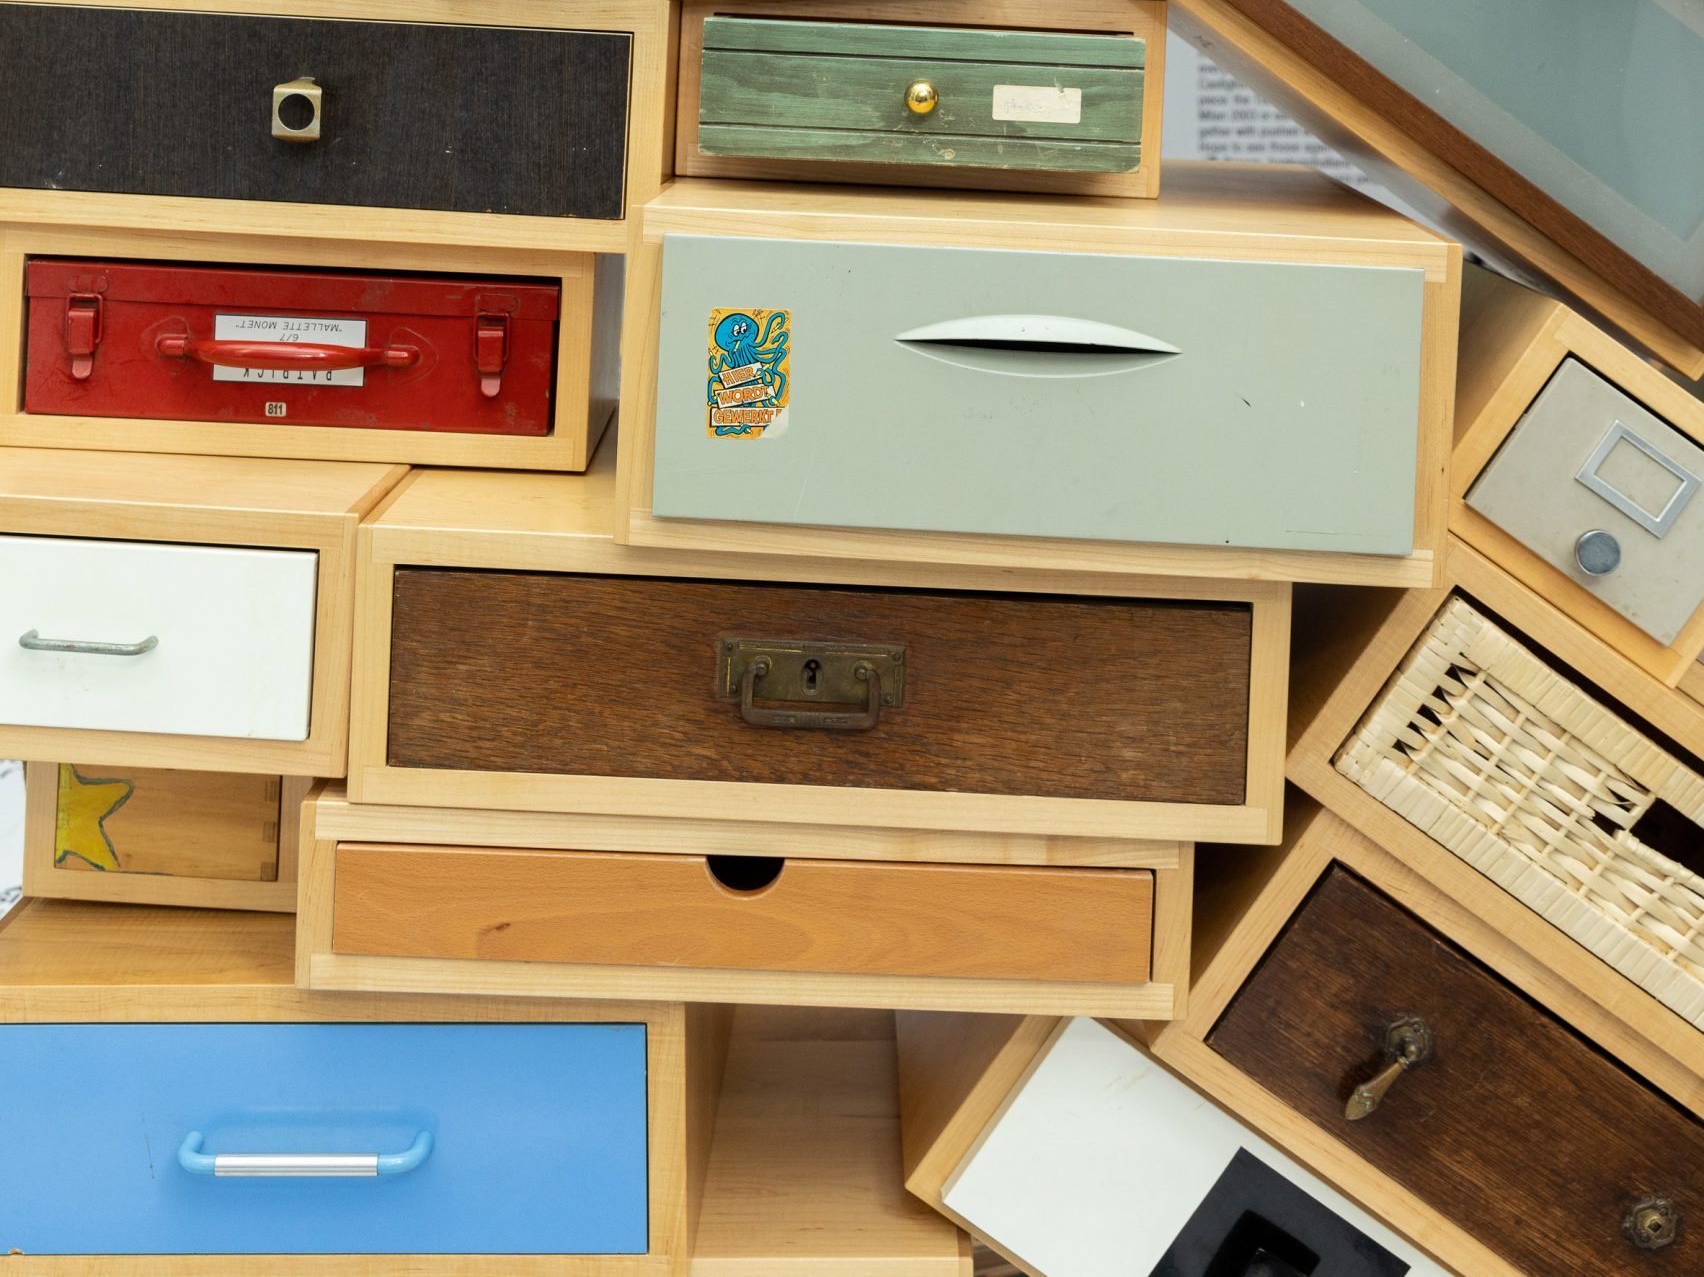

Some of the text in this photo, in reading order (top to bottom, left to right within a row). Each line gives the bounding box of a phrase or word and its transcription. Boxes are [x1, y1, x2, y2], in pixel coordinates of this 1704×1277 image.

[235, 319, 277, 330] MONET"
[721, 366, 756, 387] HIER
[718, 386, 769, 404] WORDT
[713, 408, 774, 425] GEWERKT
